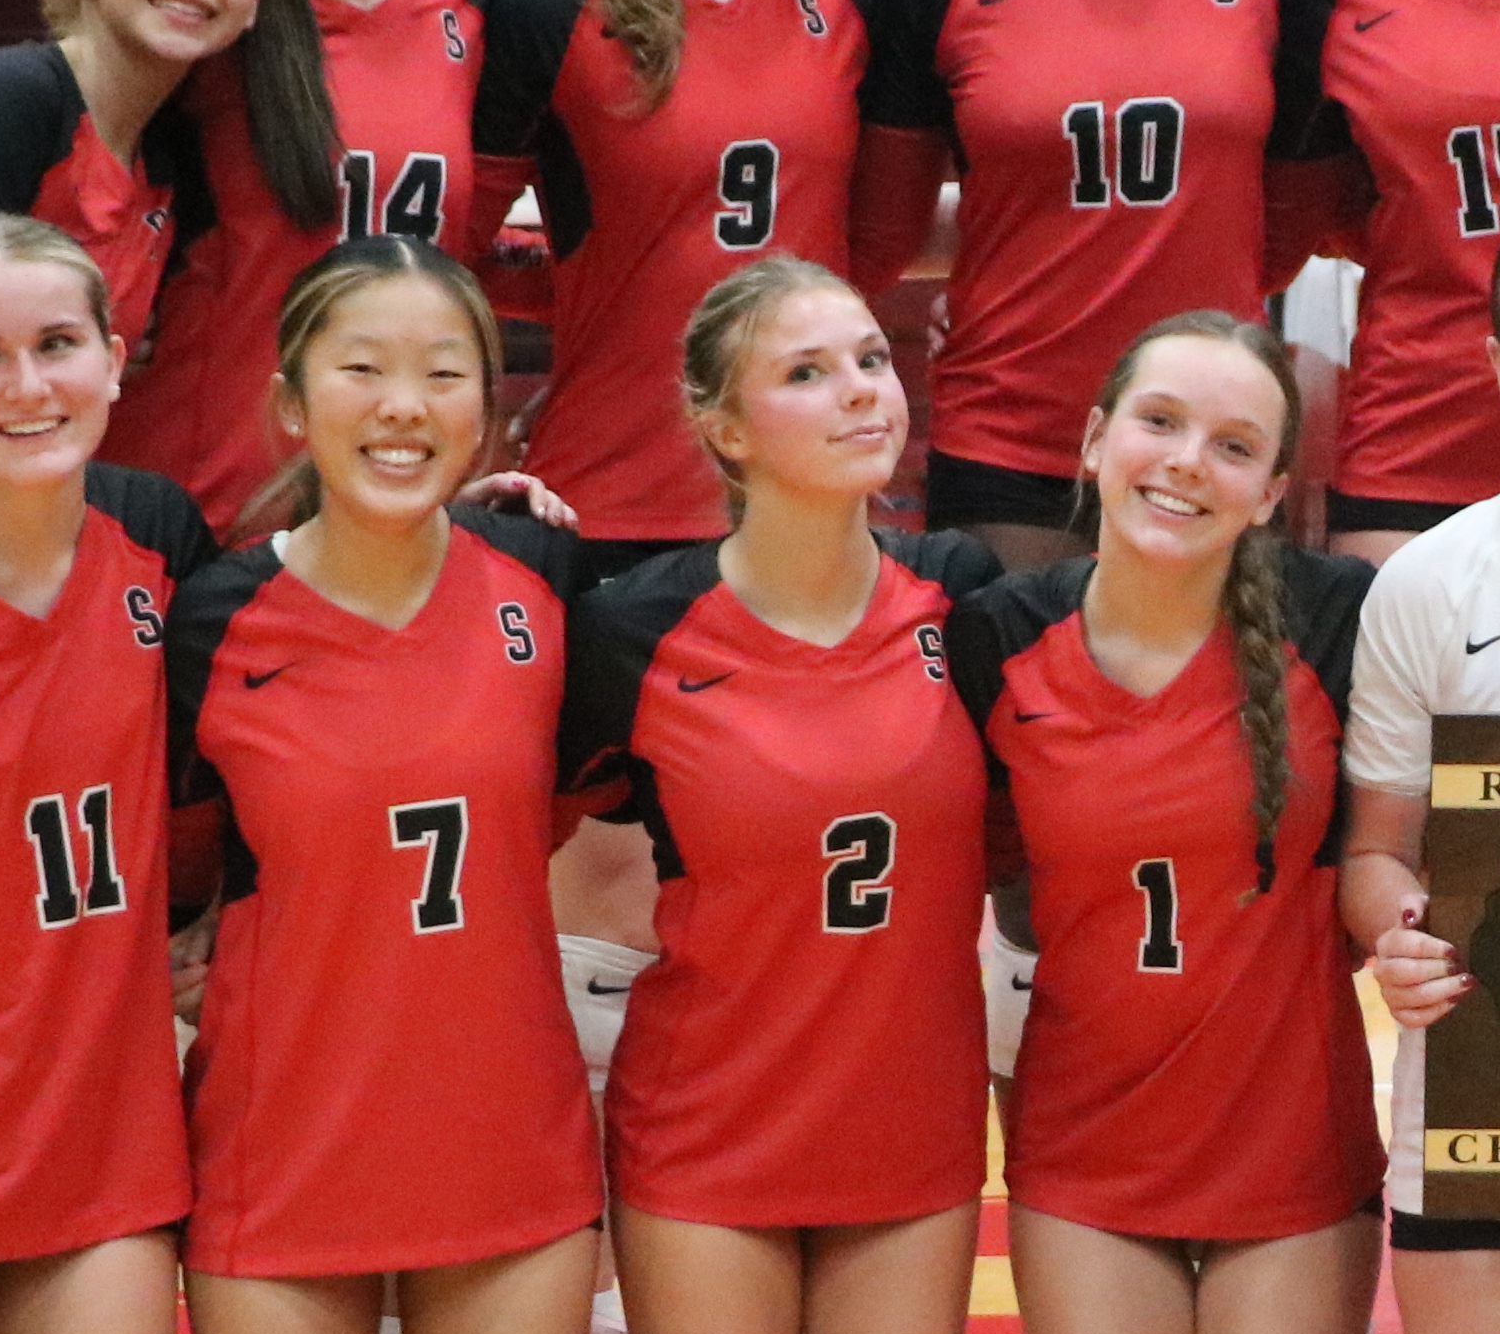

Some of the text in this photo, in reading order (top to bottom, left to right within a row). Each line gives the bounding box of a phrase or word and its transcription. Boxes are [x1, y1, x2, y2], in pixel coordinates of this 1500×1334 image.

[439, 8, 467, 62] S
[338, 149, 446, 245] 14
[713, 138, 780, 252] 9
[1061, 96, 1185, 209] 10
[122, 584, 165, 648] S
[496, 601, 538, 665] S
[913, 623, 945, 683] S
[25, 782, 128, 929] 11
[387, 795, 469, 936] 7
[821, 810, 898, 935] 2
[1132, 856, 1183, 975] 1
